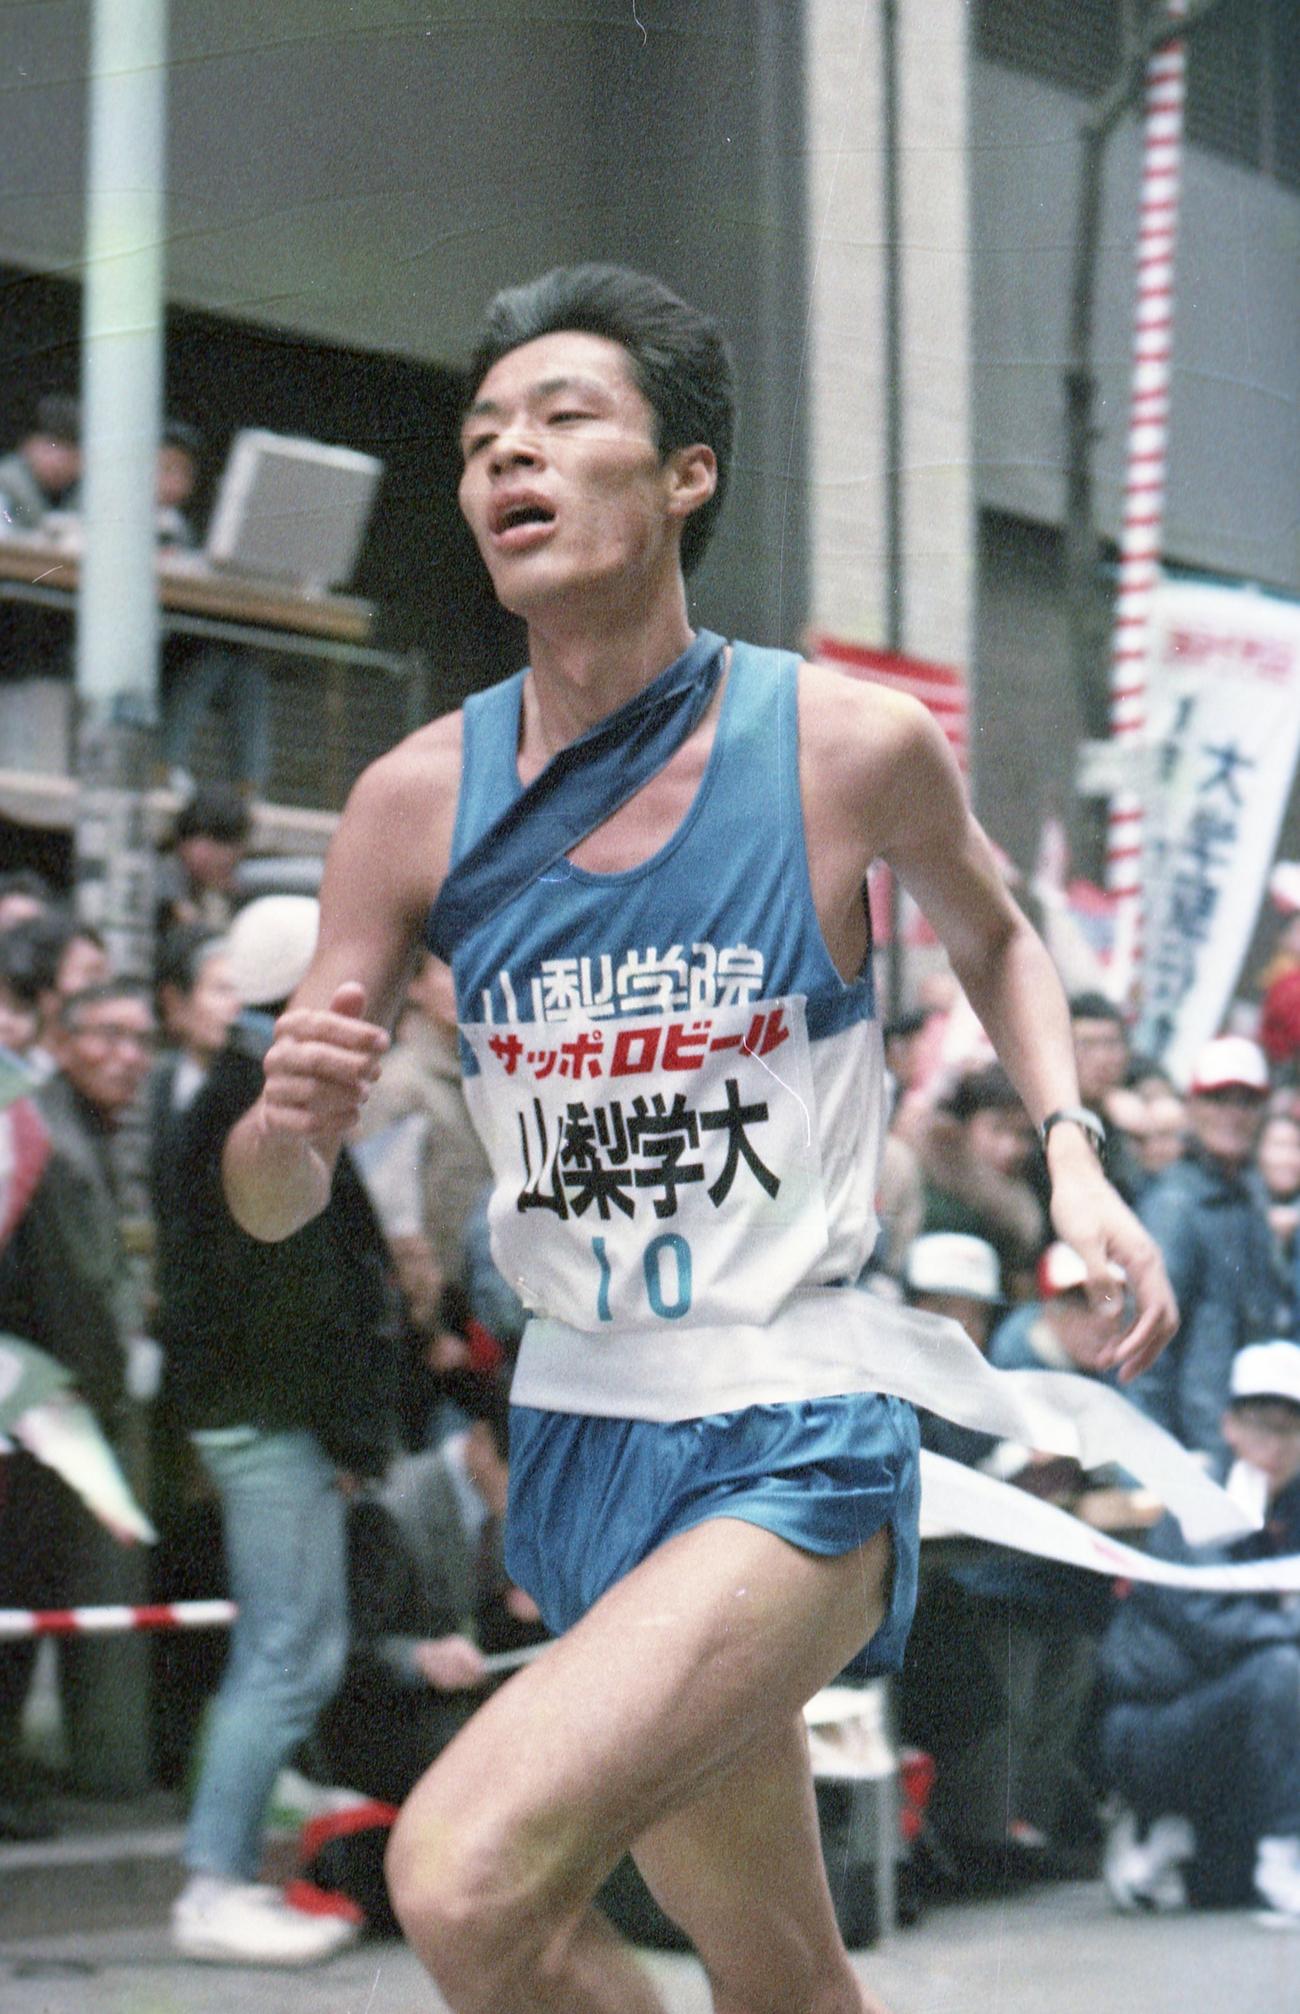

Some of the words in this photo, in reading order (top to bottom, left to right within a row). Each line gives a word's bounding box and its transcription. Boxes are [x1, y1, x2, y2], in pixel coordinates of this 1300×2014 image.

[488, 1009, 789, 1080] サッポロビール
[517, 1079, 781, 1220] 山梨学大
[591, 1232, 692, 1321] 10
